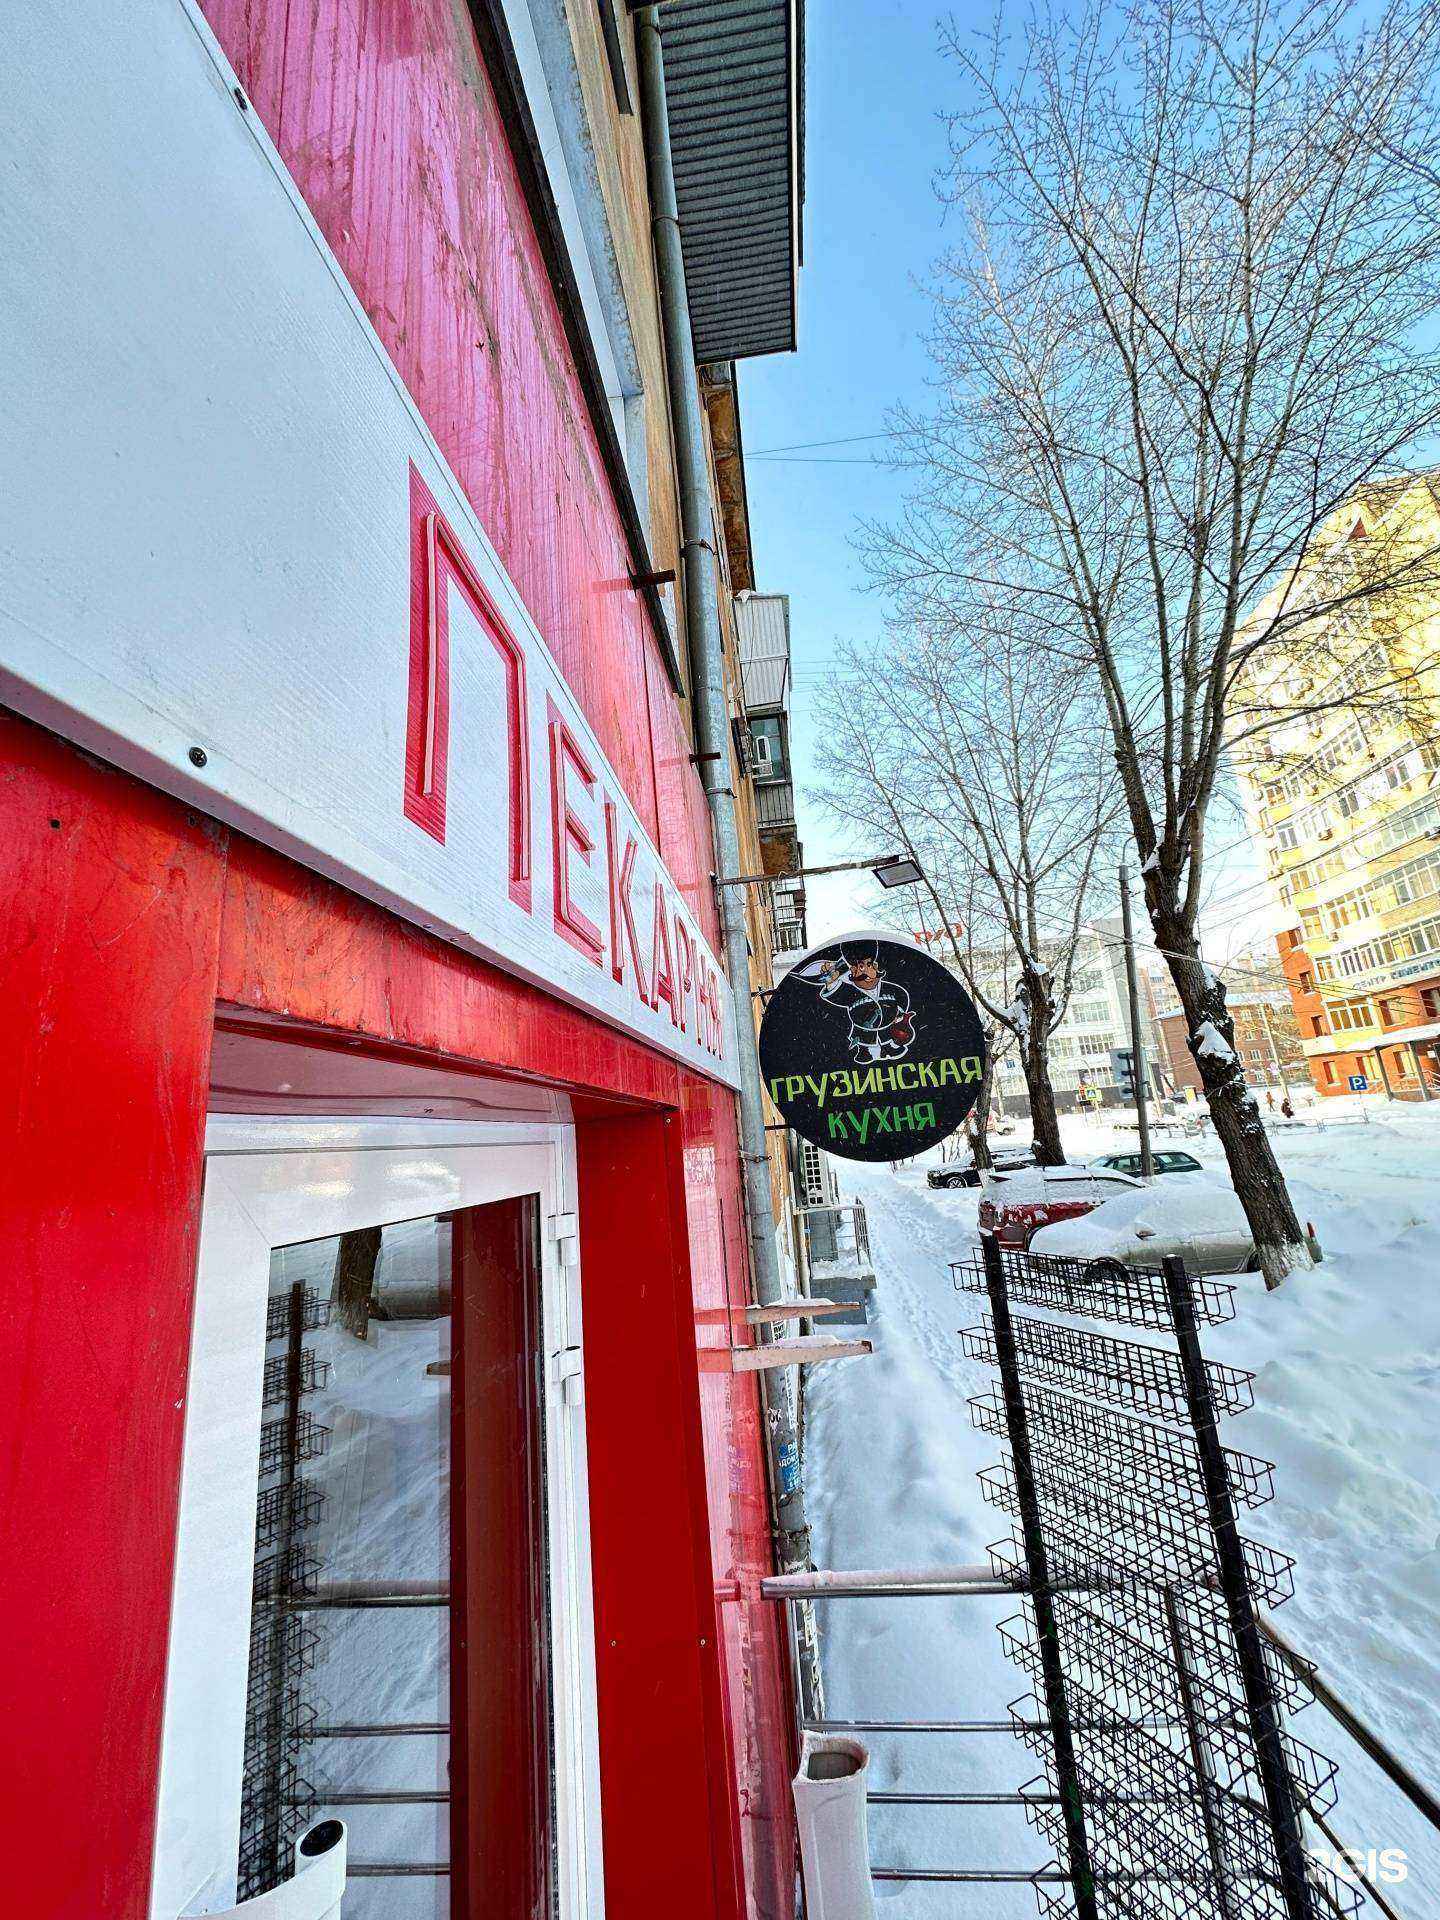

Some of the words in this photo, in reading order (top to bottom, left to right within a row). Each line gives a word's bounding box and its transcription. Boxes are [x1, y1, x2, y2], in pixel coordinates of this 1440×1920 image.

[404, 456, 723, 1060] ПЕКАРНЯ
[770, 1056, 983, 1107] ГРУЗИНСКАЯ
[827, 1102, 936, 1145] КУХНЯ
